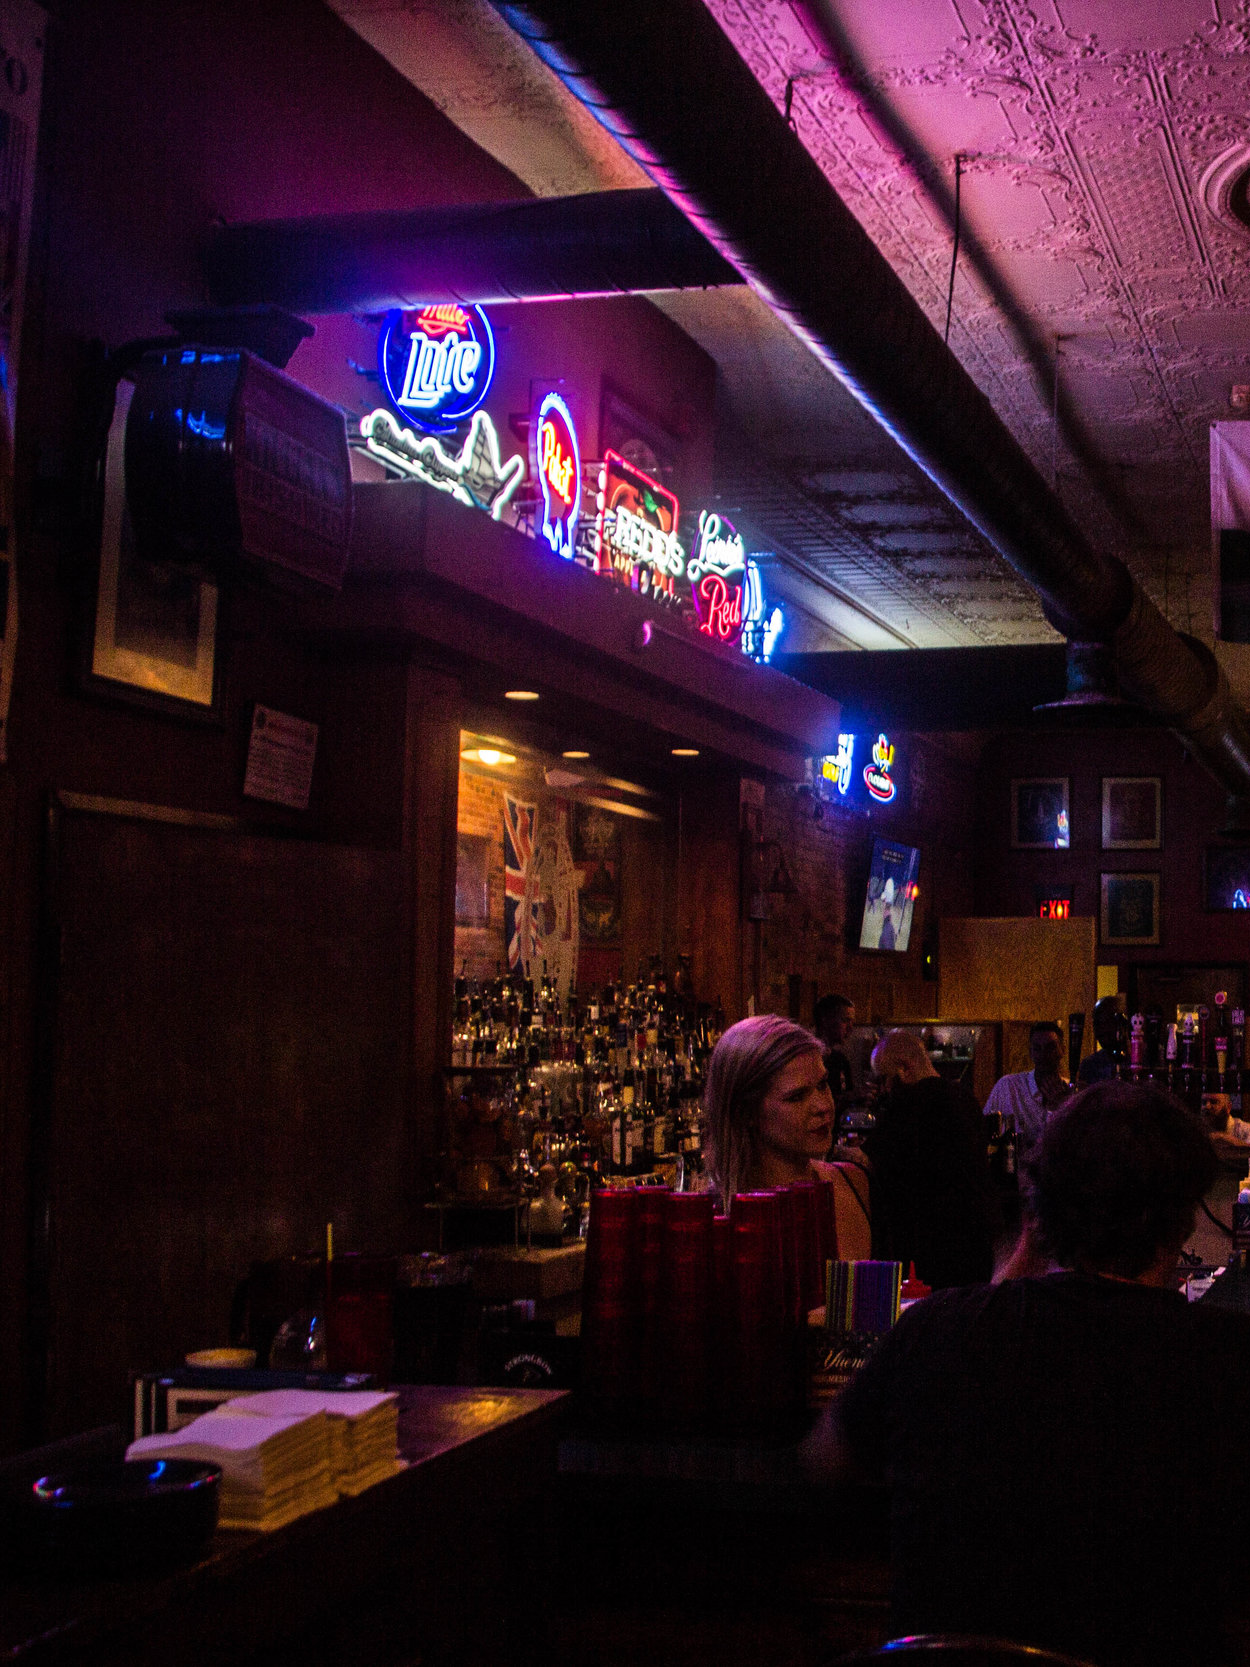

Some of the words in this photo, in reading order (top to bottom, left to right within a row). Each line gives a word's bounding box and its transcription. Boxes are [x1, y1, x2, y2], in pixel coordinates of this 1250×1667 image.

[397, 331, 482, 408] Lite
[700, 573, 743, 640] Red
[1040, 899, 1070, 920] EXIT
